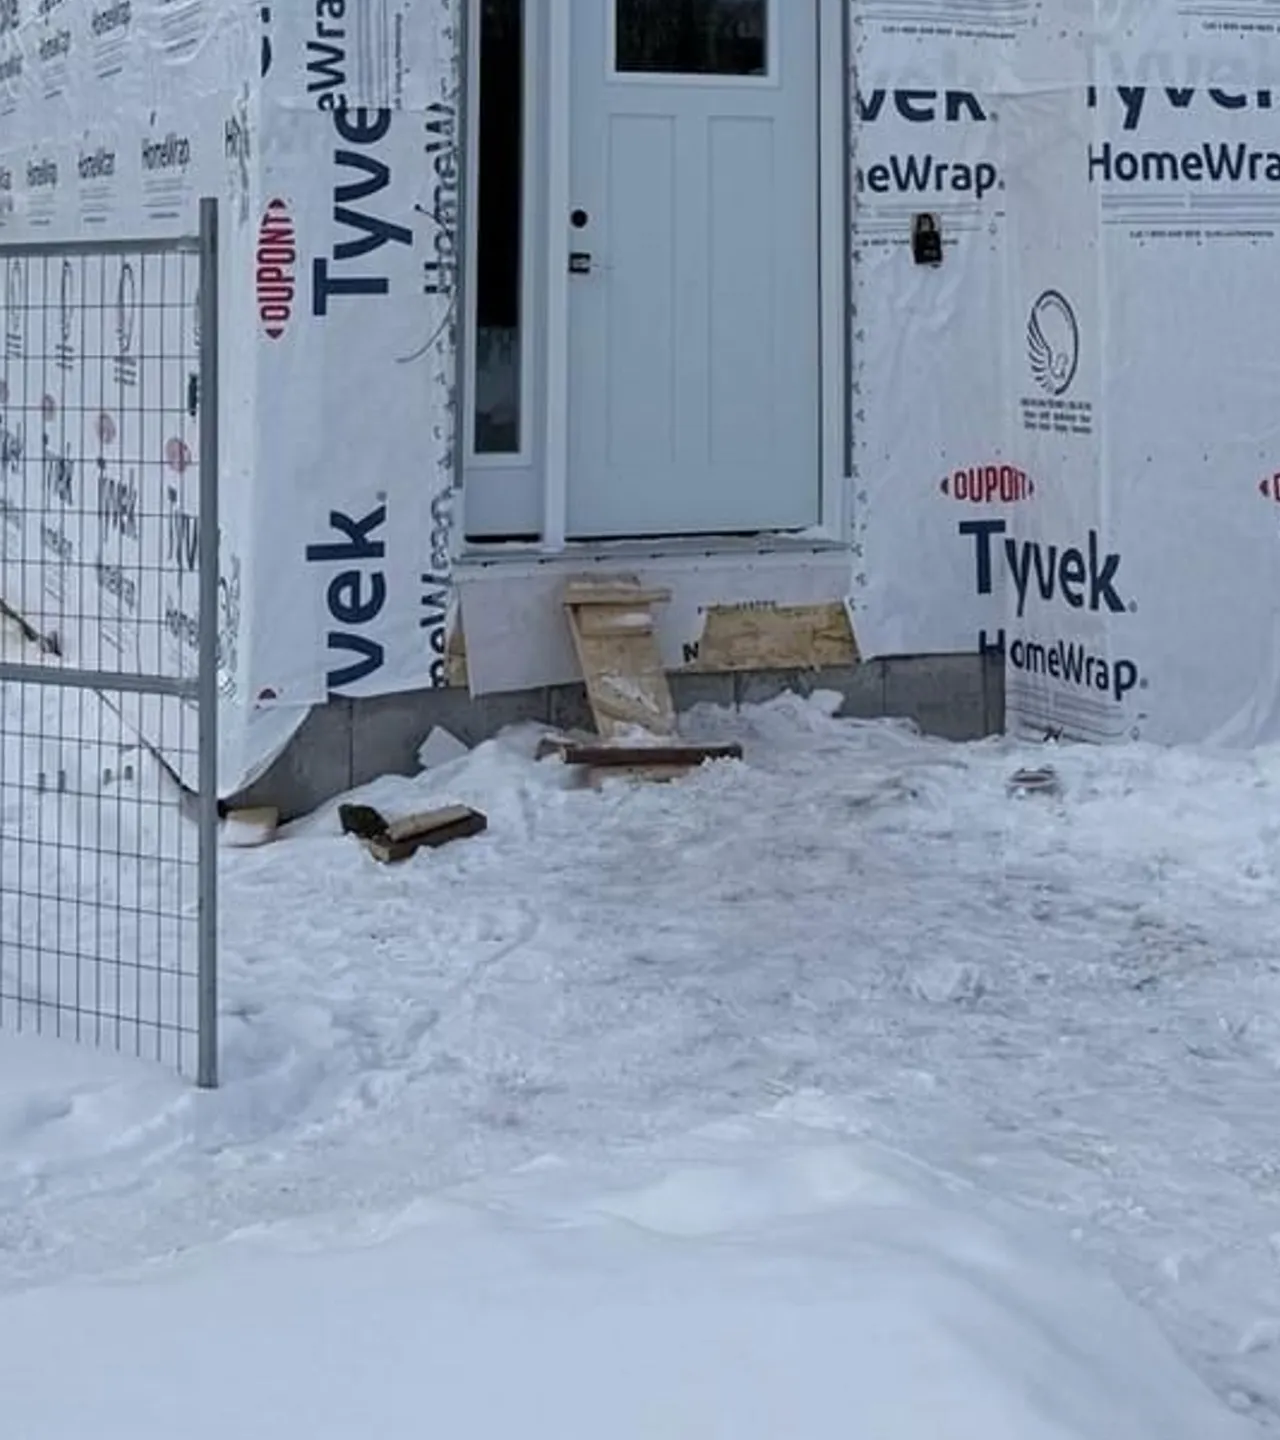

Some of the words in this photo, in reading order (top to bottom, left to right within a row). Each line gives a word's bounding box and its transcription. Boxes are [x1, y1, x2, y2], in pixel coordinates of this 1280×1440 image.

[257, 212, 296, 322] DUPONT
[959, 519, 1126, 618] Tyvek
[978, 628, 1139, 702] HomeWrap
